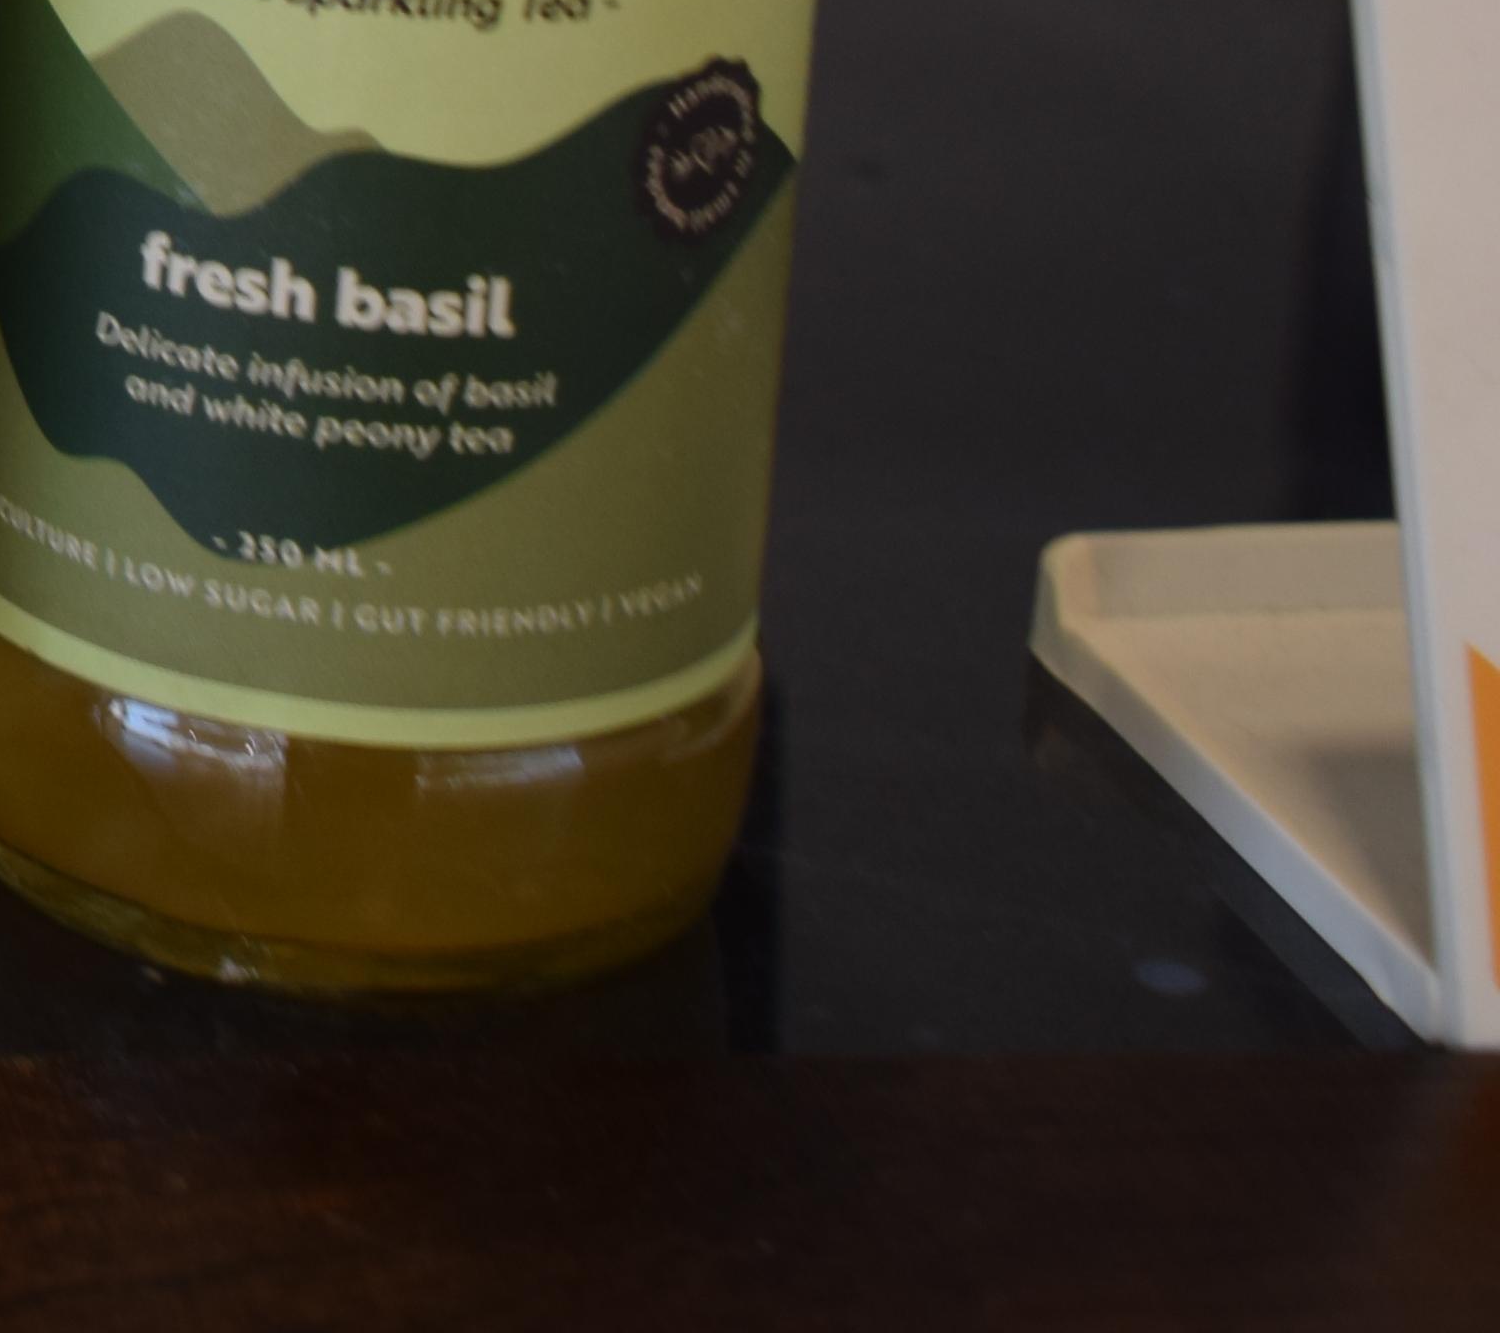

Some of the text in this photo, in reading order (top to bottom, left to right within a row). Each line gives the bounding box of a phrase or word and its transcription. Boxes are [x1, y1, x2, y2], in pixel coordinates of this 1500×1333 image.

[141, 232, 517, 339] fresh basil
[95, 311, 558, 412] Delicate infusion of basil
[125, 371, 512, 459] and white peony tea
[239, 532, 366, 579] 250 ML
